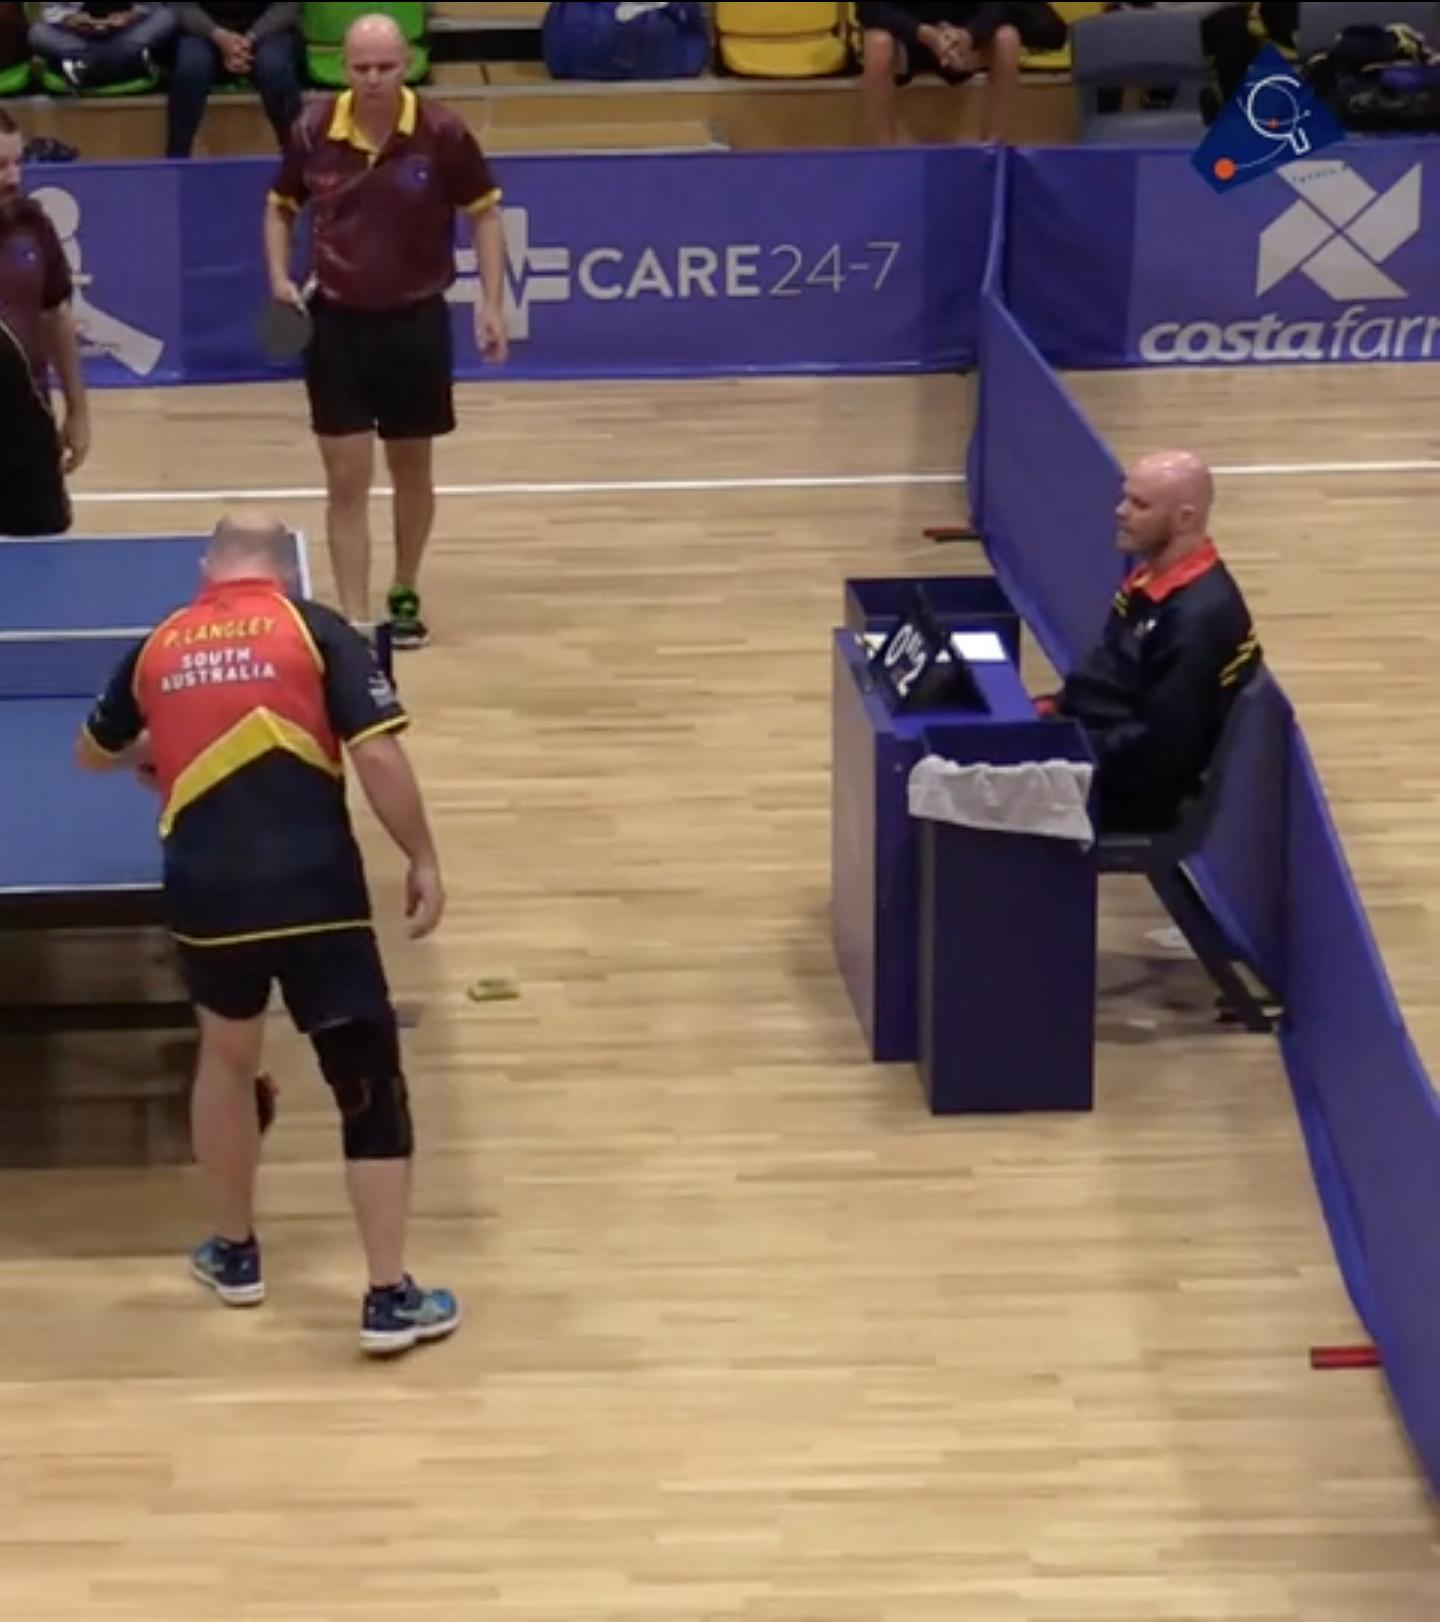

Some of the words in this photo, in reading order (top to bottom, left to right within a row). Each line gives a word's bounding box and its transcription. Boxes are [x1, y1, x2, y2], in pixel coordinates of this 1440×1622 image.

[577, 244, 761, 300] CARE
[768, 241, 901, 297] 24-7
[1138, 313, 1325, 364] costa
[184, 615, 277, 645] LANGLEY
[884, 623, 914, 667] 0
[161, 663, 276, 693] AUSTRALIA
[181, 647, 251, 669] SOUTH
[898, 652, 927, 697] 2
